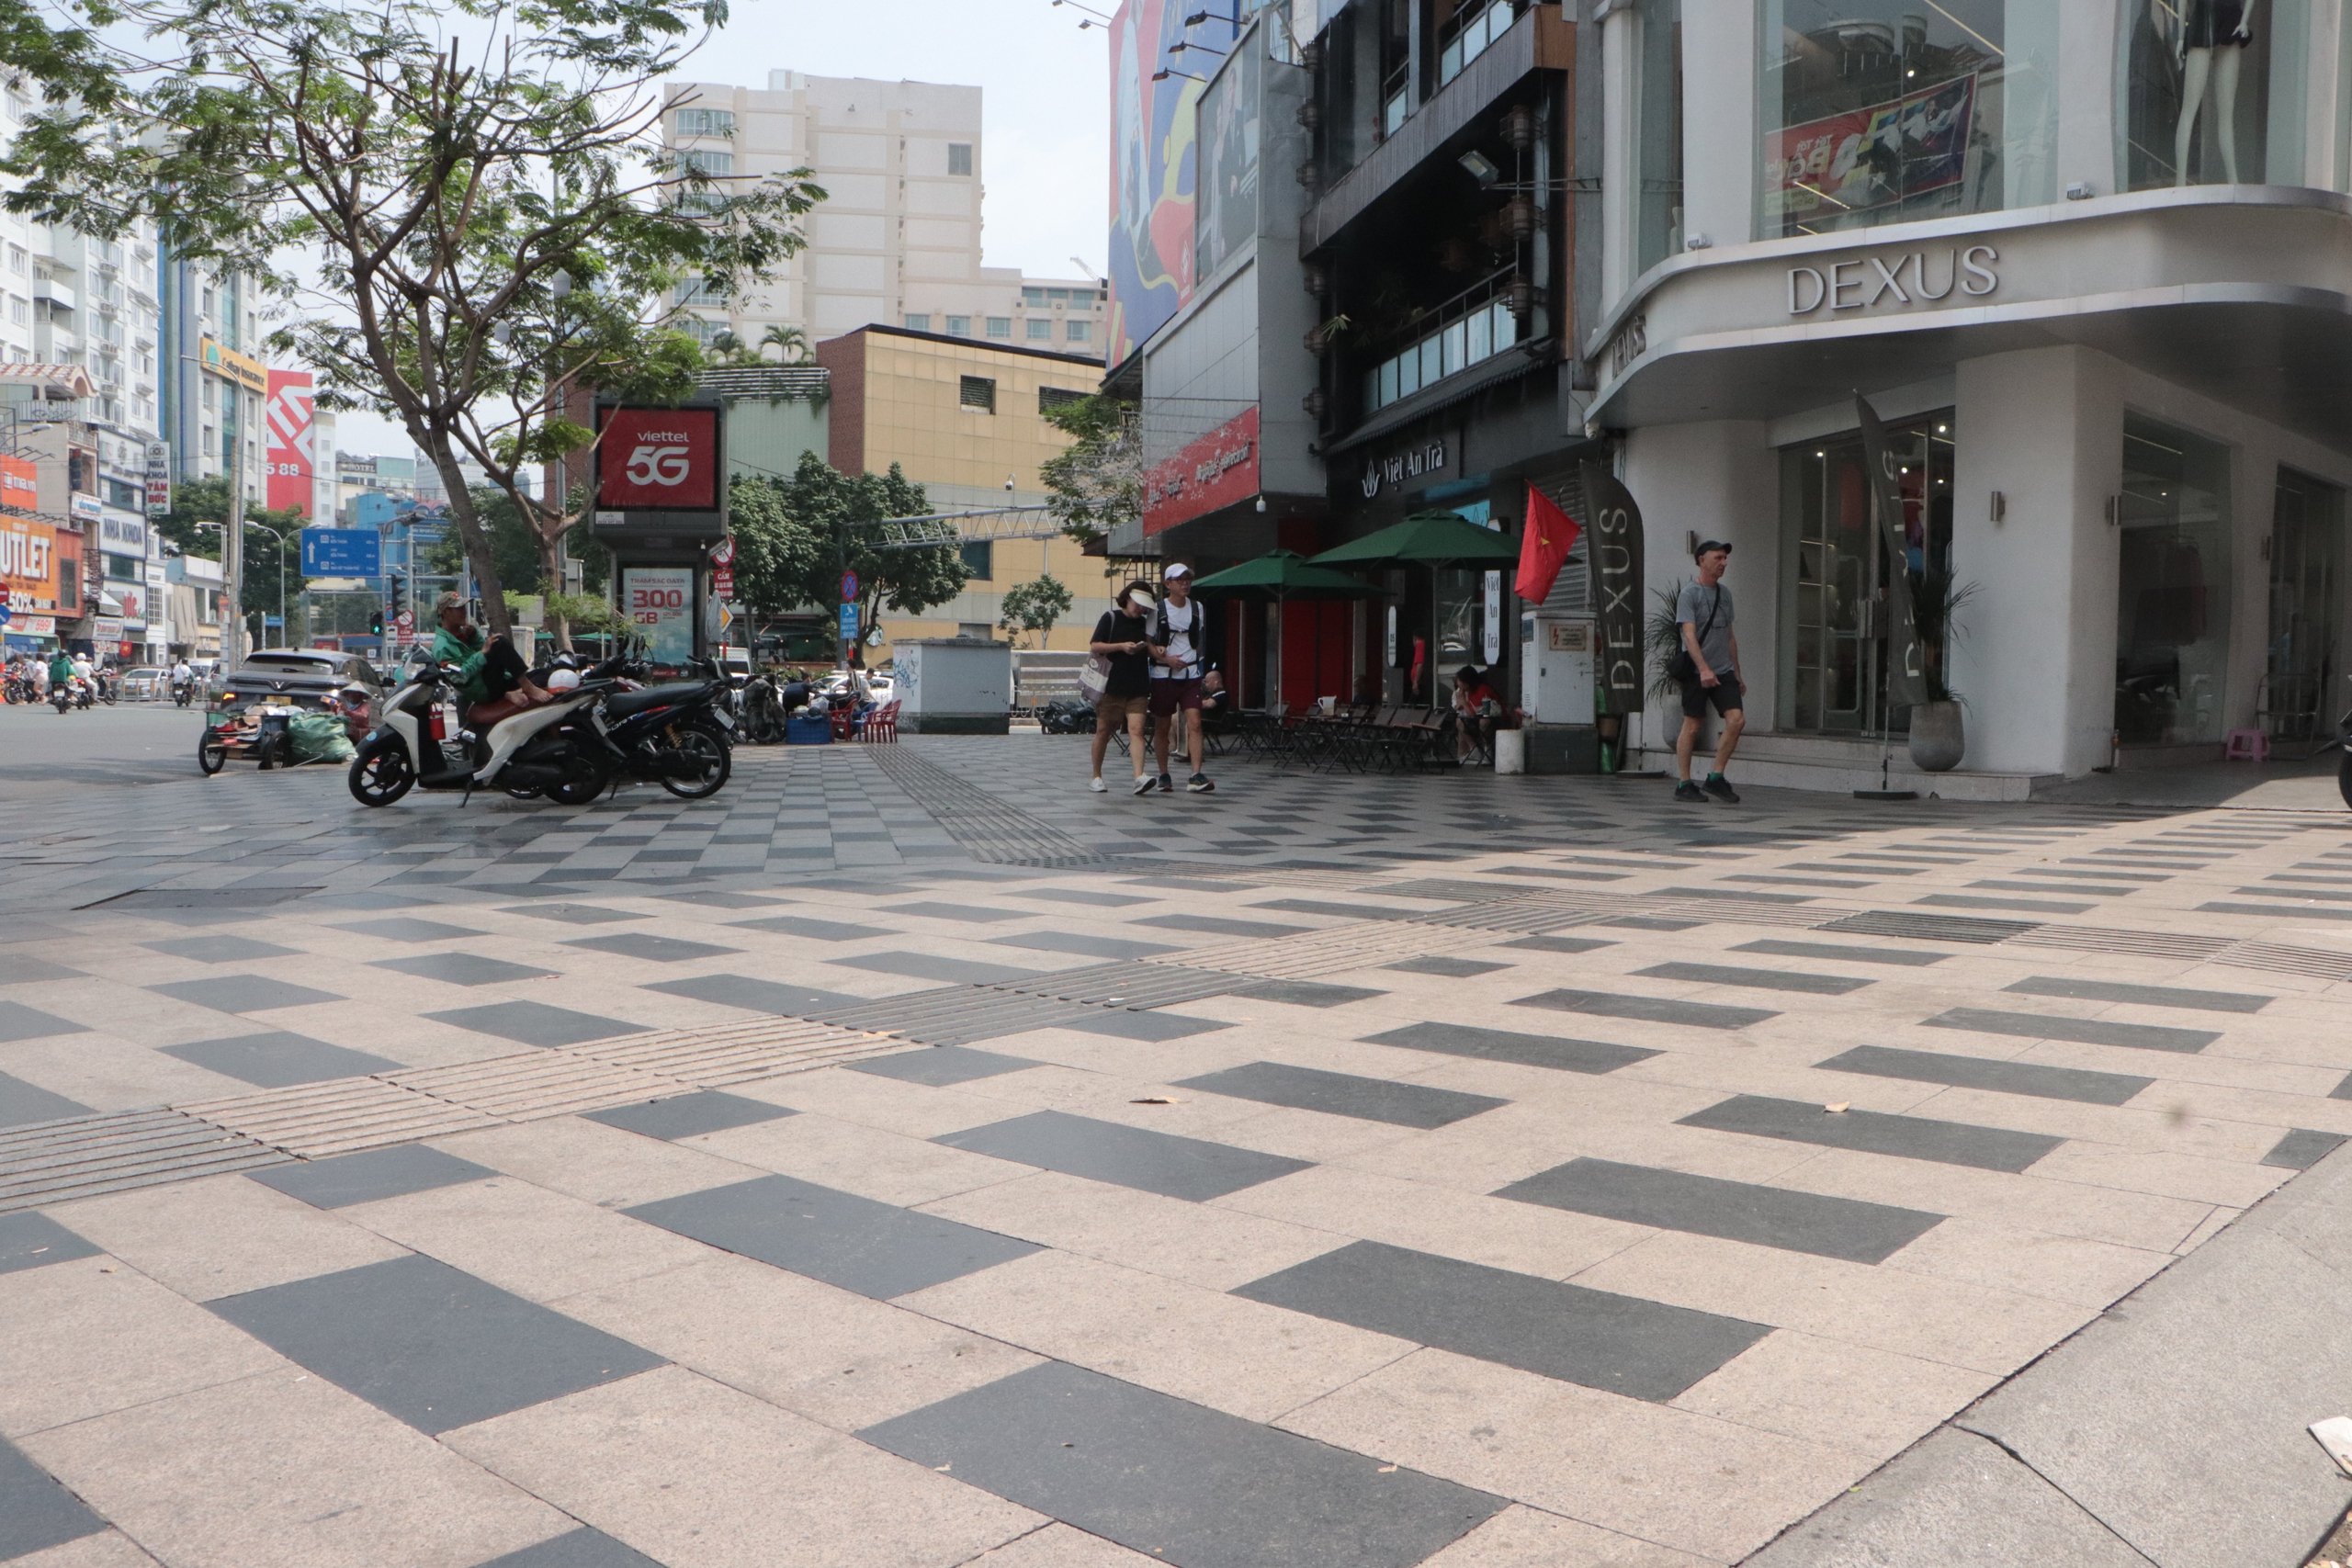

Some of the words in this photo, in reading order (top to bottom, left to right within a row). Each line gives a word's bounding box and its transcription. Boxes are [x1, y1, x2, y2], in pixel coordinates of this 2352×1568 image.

[1787, 244, 1999, 315] DEXUS
[241, 365, 265, 387] Insurance
[637, 430, 690, 443] viettel
[148, 460, 165, 468] NHA
[278, 463, 300, 477] 88
[350, 463, 376, 473] HOTEL
[626, 446, 690, 487] 5G
[1384, 457, 1403, 491] Việt
[1406, 451, 1422, 478] An
[1424, 439, 1443, 471] Trà
[146, 471, 168, 479] KHOA
[146, 480, 168, 491] TÂM
[103, 517, 120, 542] NHA
[121, 522, 142, 547] KHOA
[717, 570, 730, 581] CẤM
[1487, 576, 1499, 595] Việt
[8, 591, 34, 614] 50%
[632, 589, 683, 608] 300
[1599, 507, 1635, 690] DEXUS
[634, 611, 659, 625] GB
[1490, 603, 1498, 619] An
[1487, 631, 1498, 649] Trà
